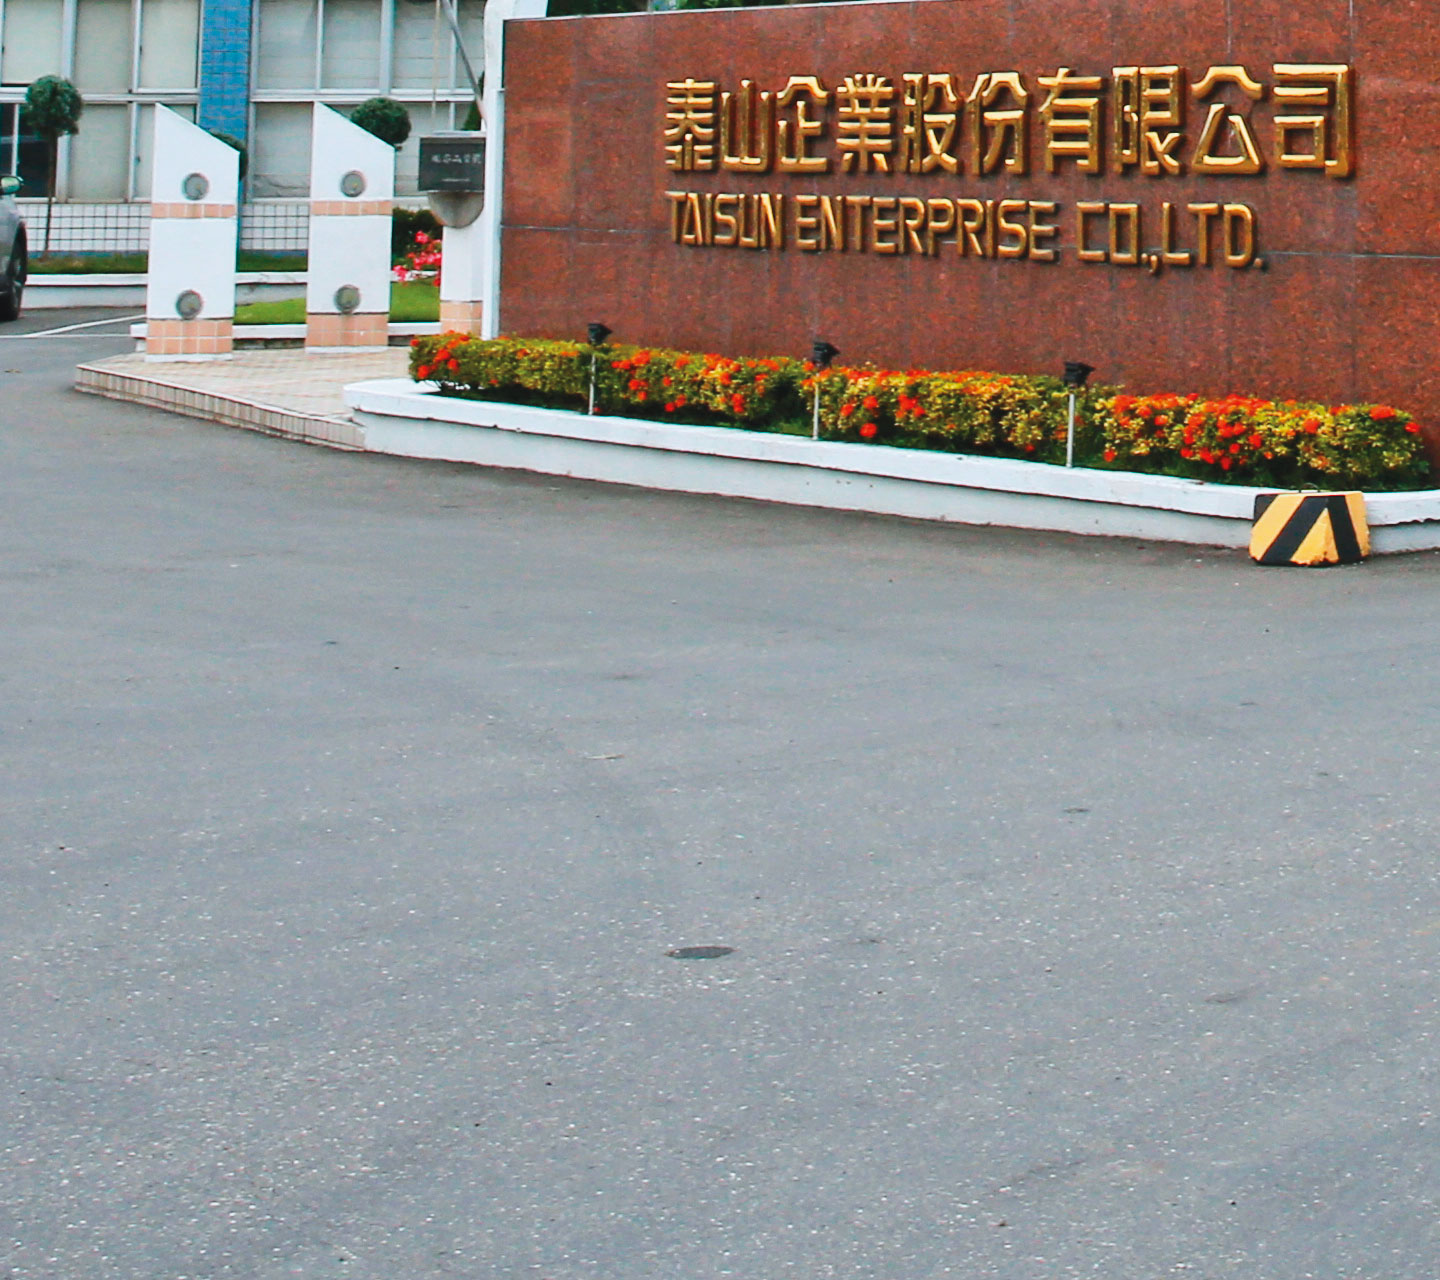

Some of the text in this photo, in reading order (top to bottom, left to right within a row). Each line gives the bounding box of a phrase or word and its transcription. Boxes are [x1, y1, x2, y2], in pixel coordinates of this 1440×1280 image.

[665, 64, 1355, 177] 泰山企業股份有限公司
[665, 190, 783, 251] TAISUN
[796, 194, 1059, 262] ENTERPRISE
